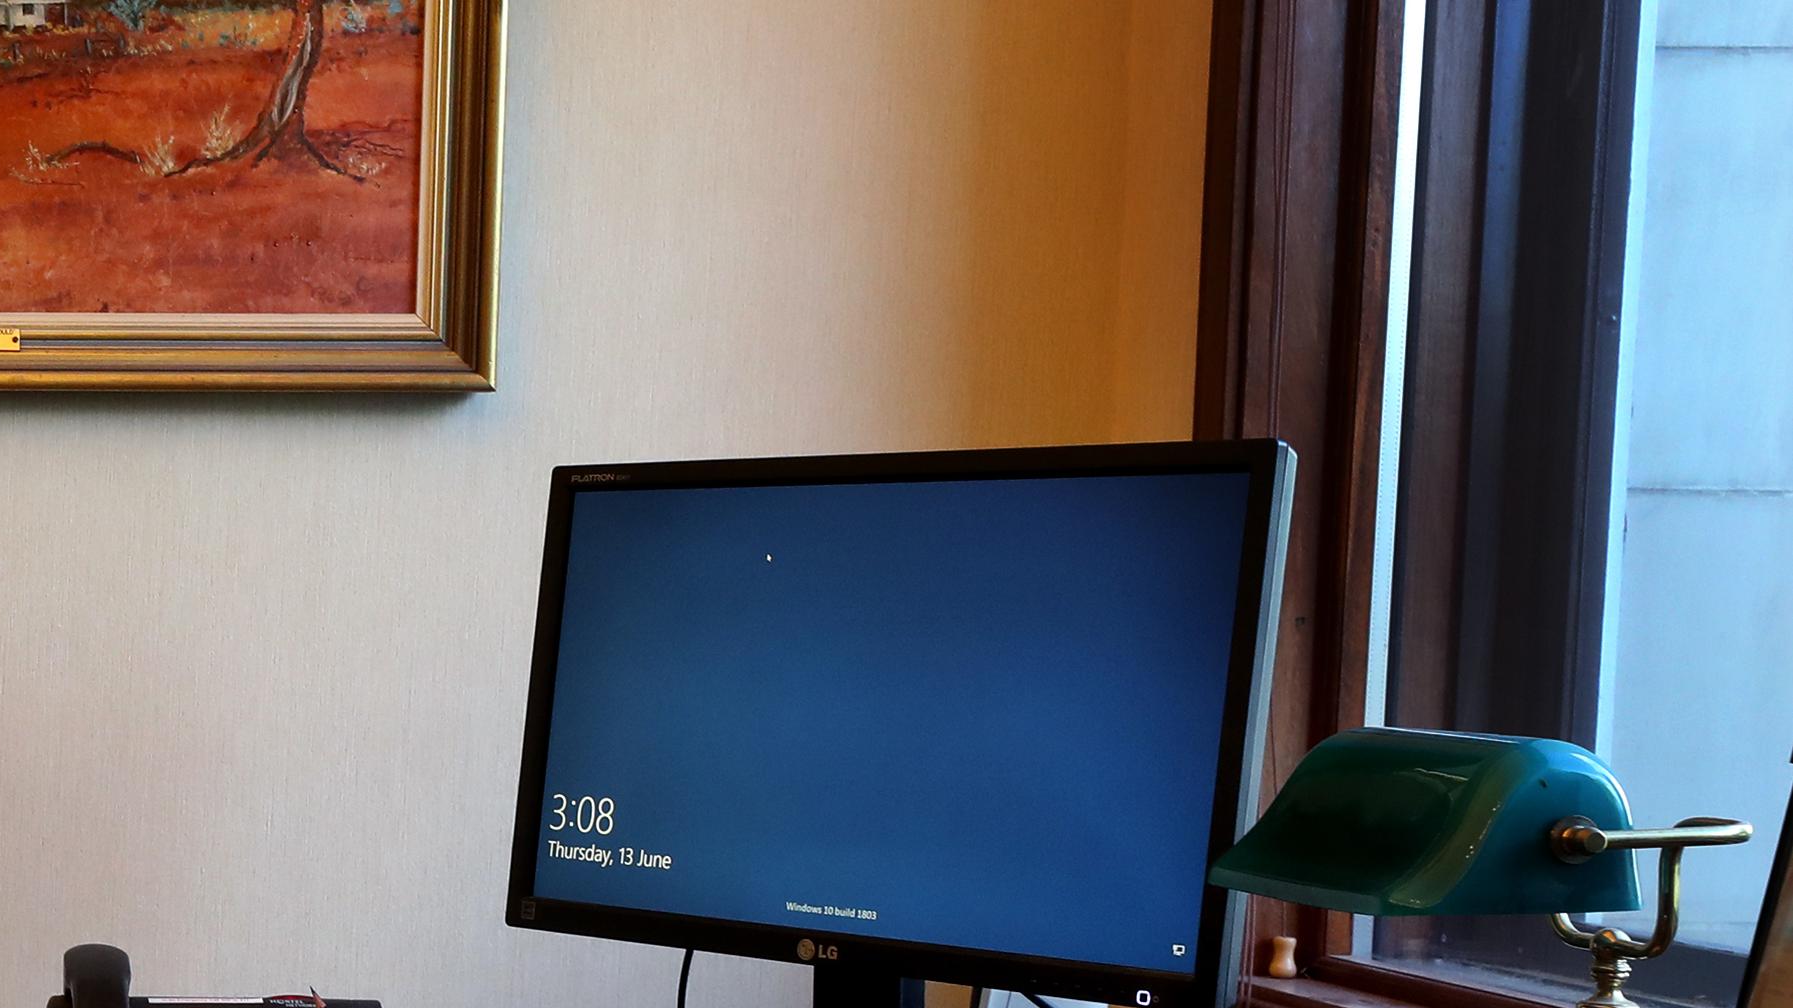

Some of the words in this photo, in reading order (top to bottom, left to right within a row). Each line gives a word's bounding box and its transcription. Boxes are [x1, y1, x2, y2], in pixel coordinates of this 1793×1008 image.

[571, 473, 615, 483] FLATRON
[549, 794, 615, 835] 3:08
[548, 840, 613, 867] Thursday,
[619, 847, 634, 866] 13
[636, 849, 672, 870] June
[786, 901, 822, 915] Windows
[824, 905, 834, 916] 10
[835, 906, 856, 918] build
[857, 909, 877, 920] 1803
[818, 944, 838, 960] LG
